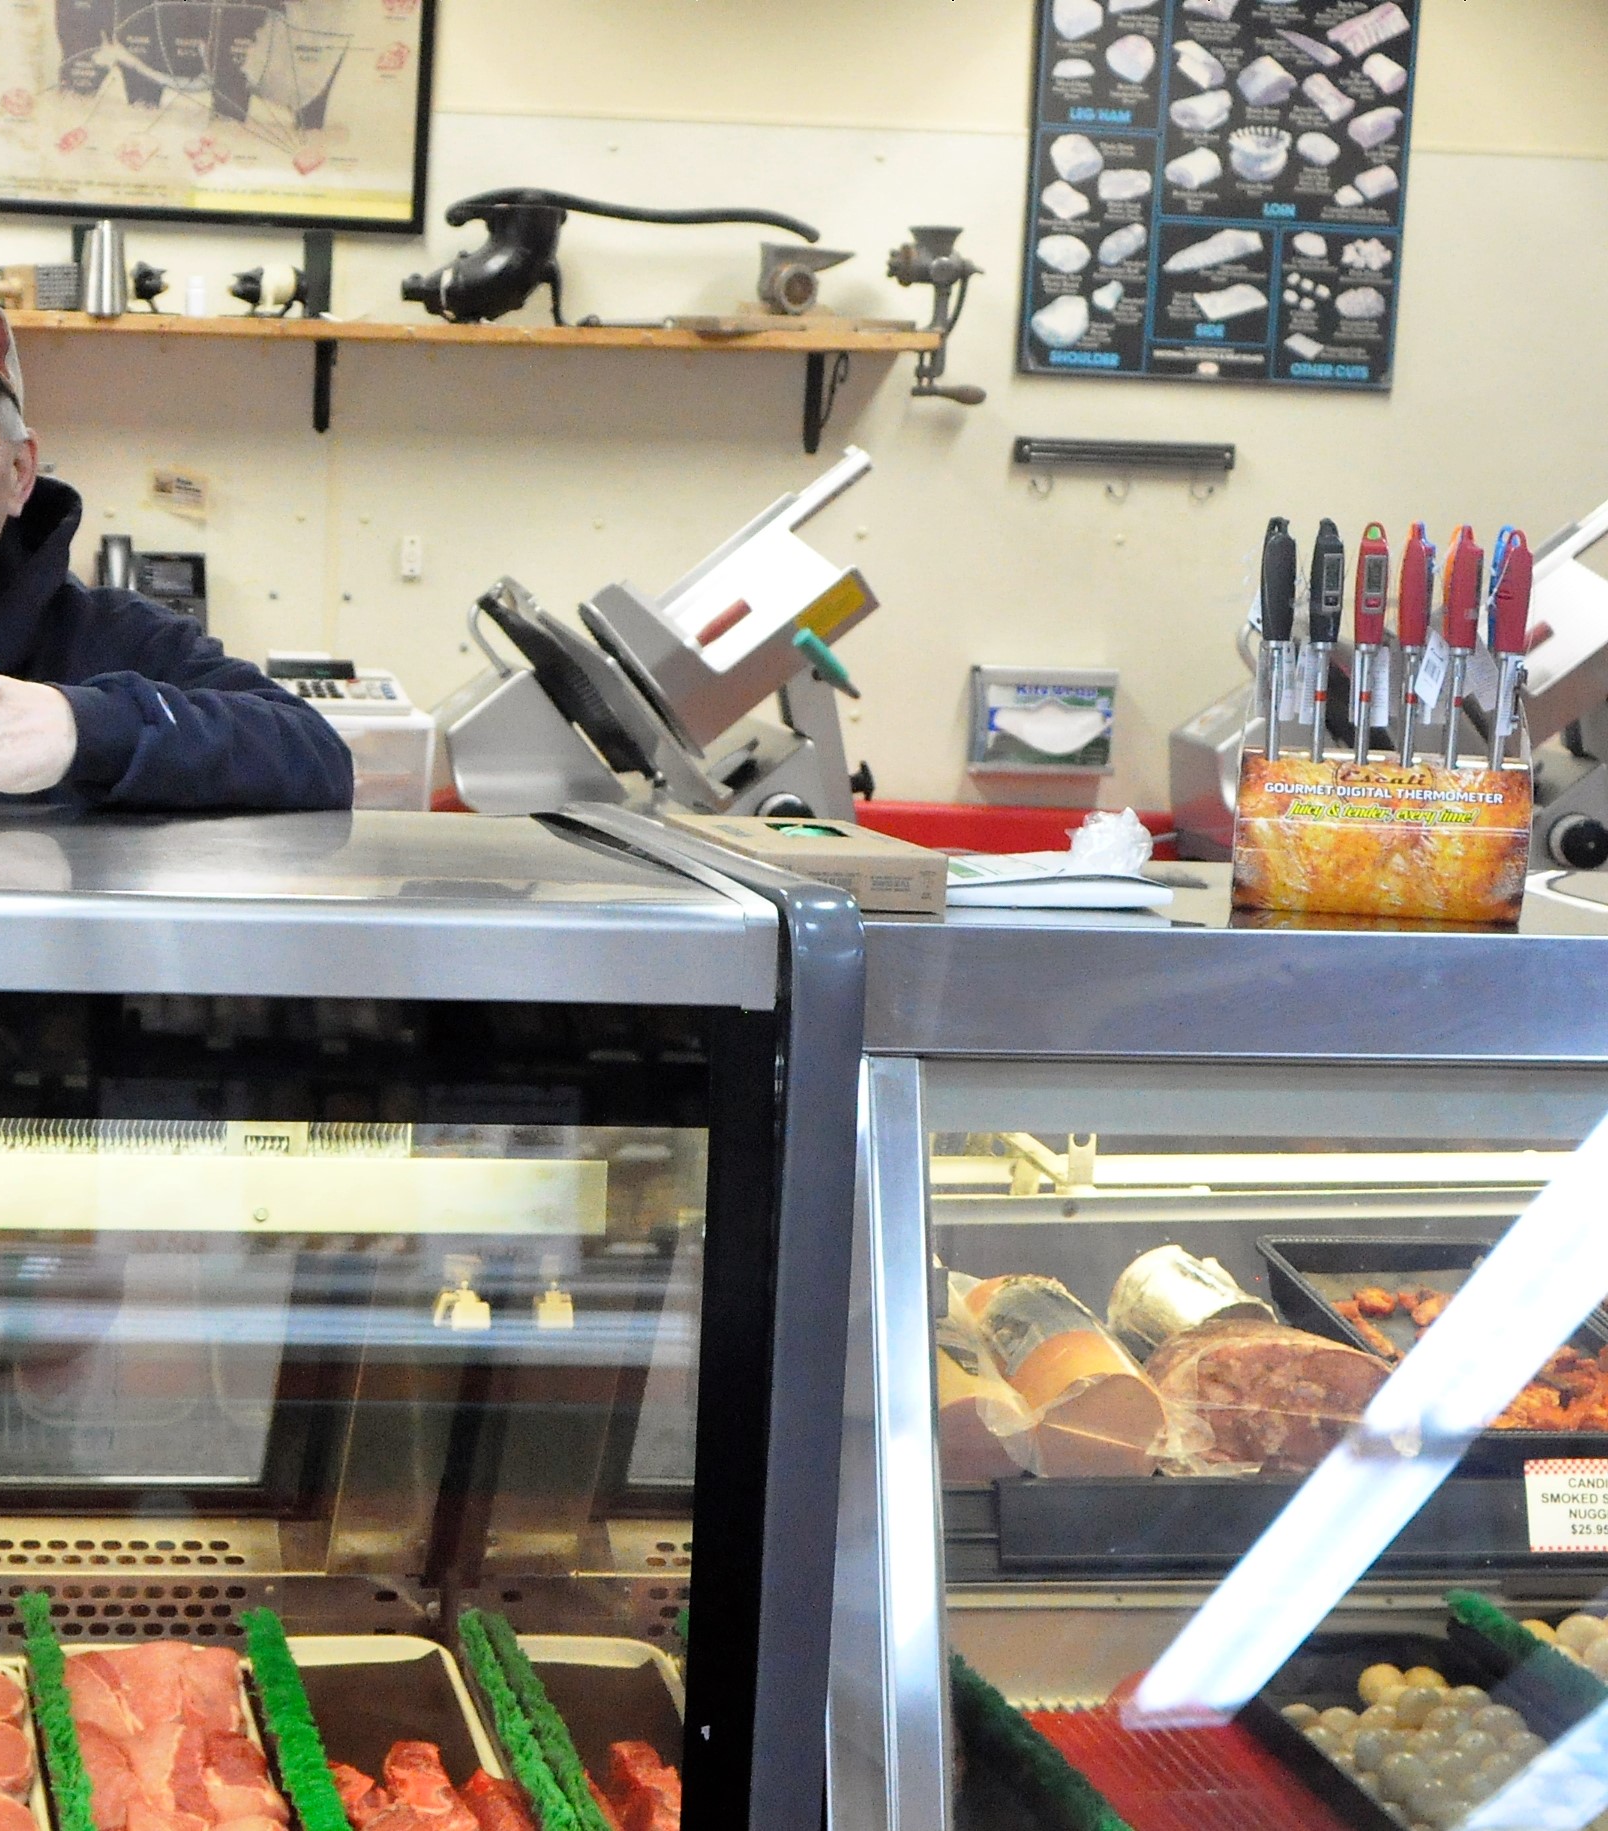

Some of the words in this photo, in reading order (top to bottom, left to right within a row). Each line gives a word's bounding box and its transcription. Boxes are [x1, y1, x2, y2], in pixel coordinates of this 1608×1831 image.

[1291, 363, 1333, 378] OTHER
[1264, 782, 1333, 795] GOURMET
[1336, 785, 1392, 798] DIGITAL
[1397, 788, 1504, 804] THERMOMETER
[1285, 800, 1323, 819] Juicy
[1327, 803, 1340, 817] &
[1396, 809, 1437, 825] every
[1439, 808, 1478, 823] time!
[1541, 1492, 1598, 1504] SMOKED
